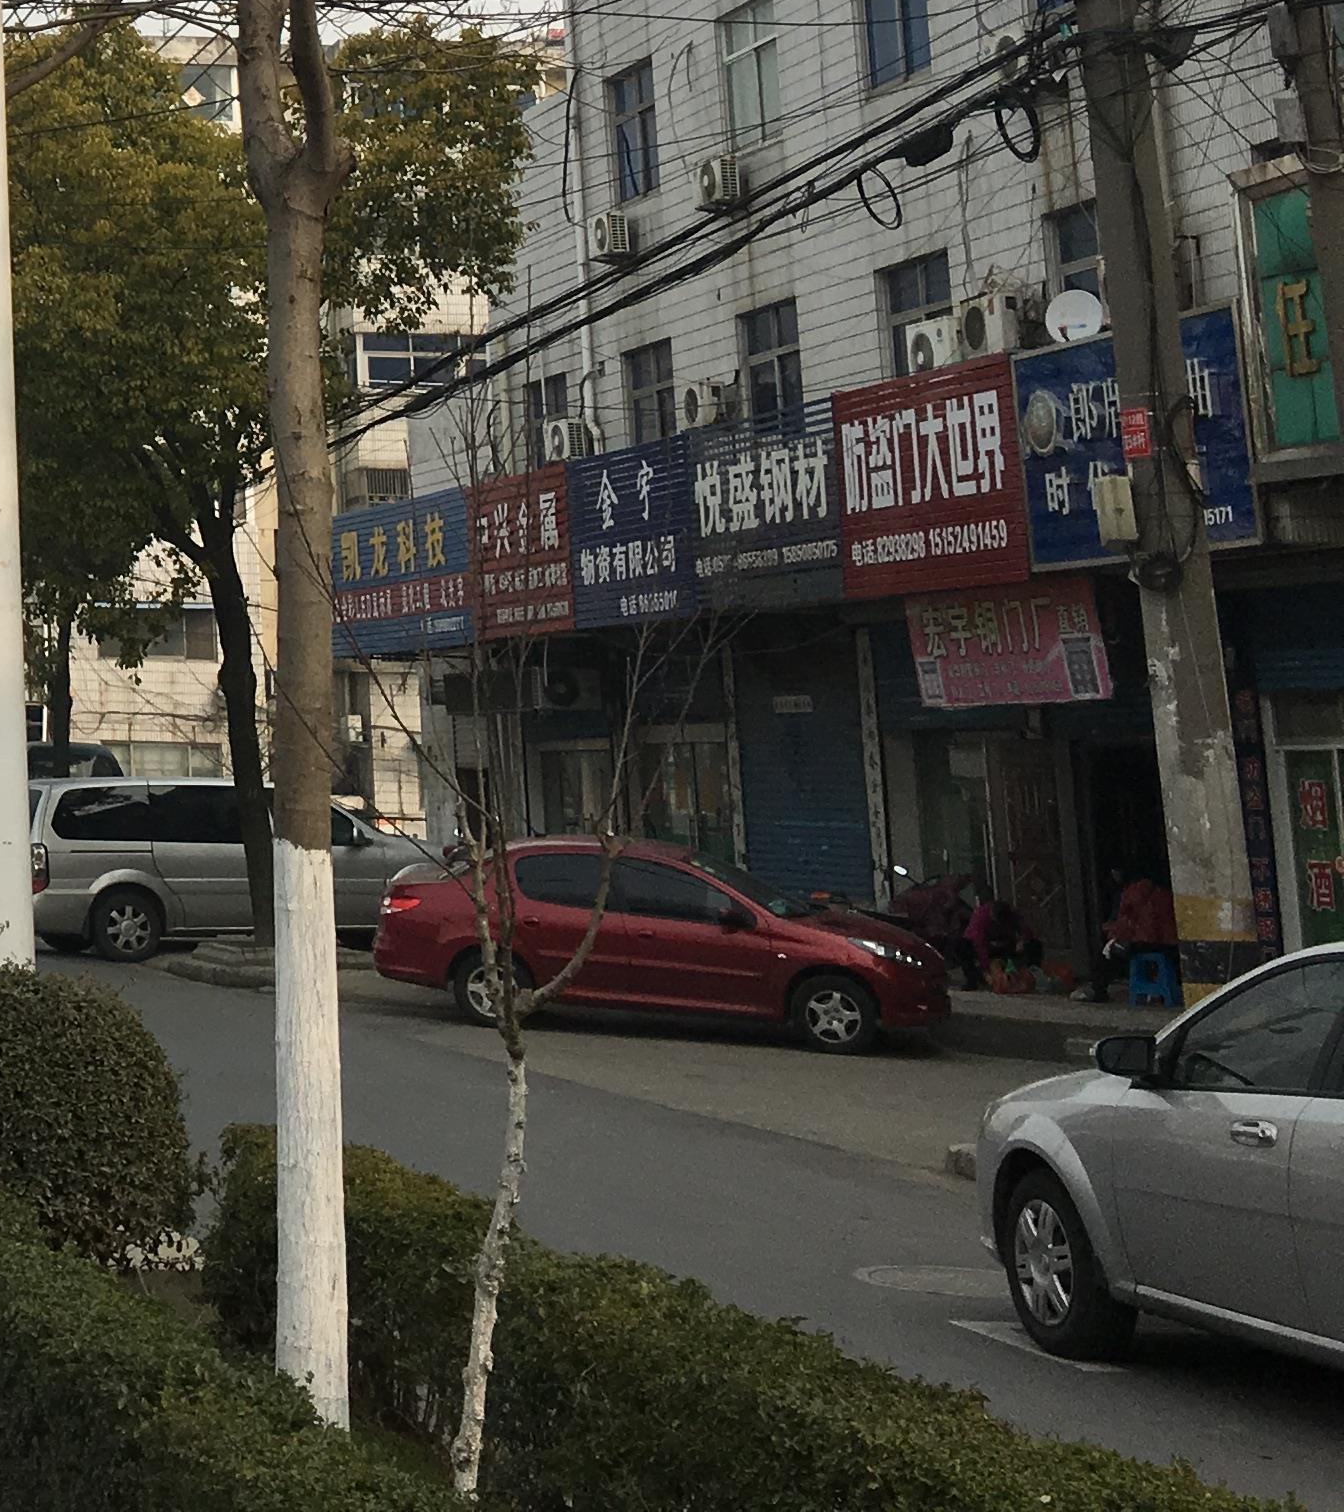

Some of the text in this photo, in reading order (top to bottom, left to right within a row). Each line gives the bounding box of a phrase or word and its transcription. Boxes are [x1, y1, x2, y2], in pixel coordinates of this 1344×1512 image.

[695, 436, 828, 537] 悦盛钢材
[841, 390, 1005, 515] 防盗门大世界
[340, 511, 446, 582] 凯龙科技
[580, 535, 676, 585] 物资有限公司
